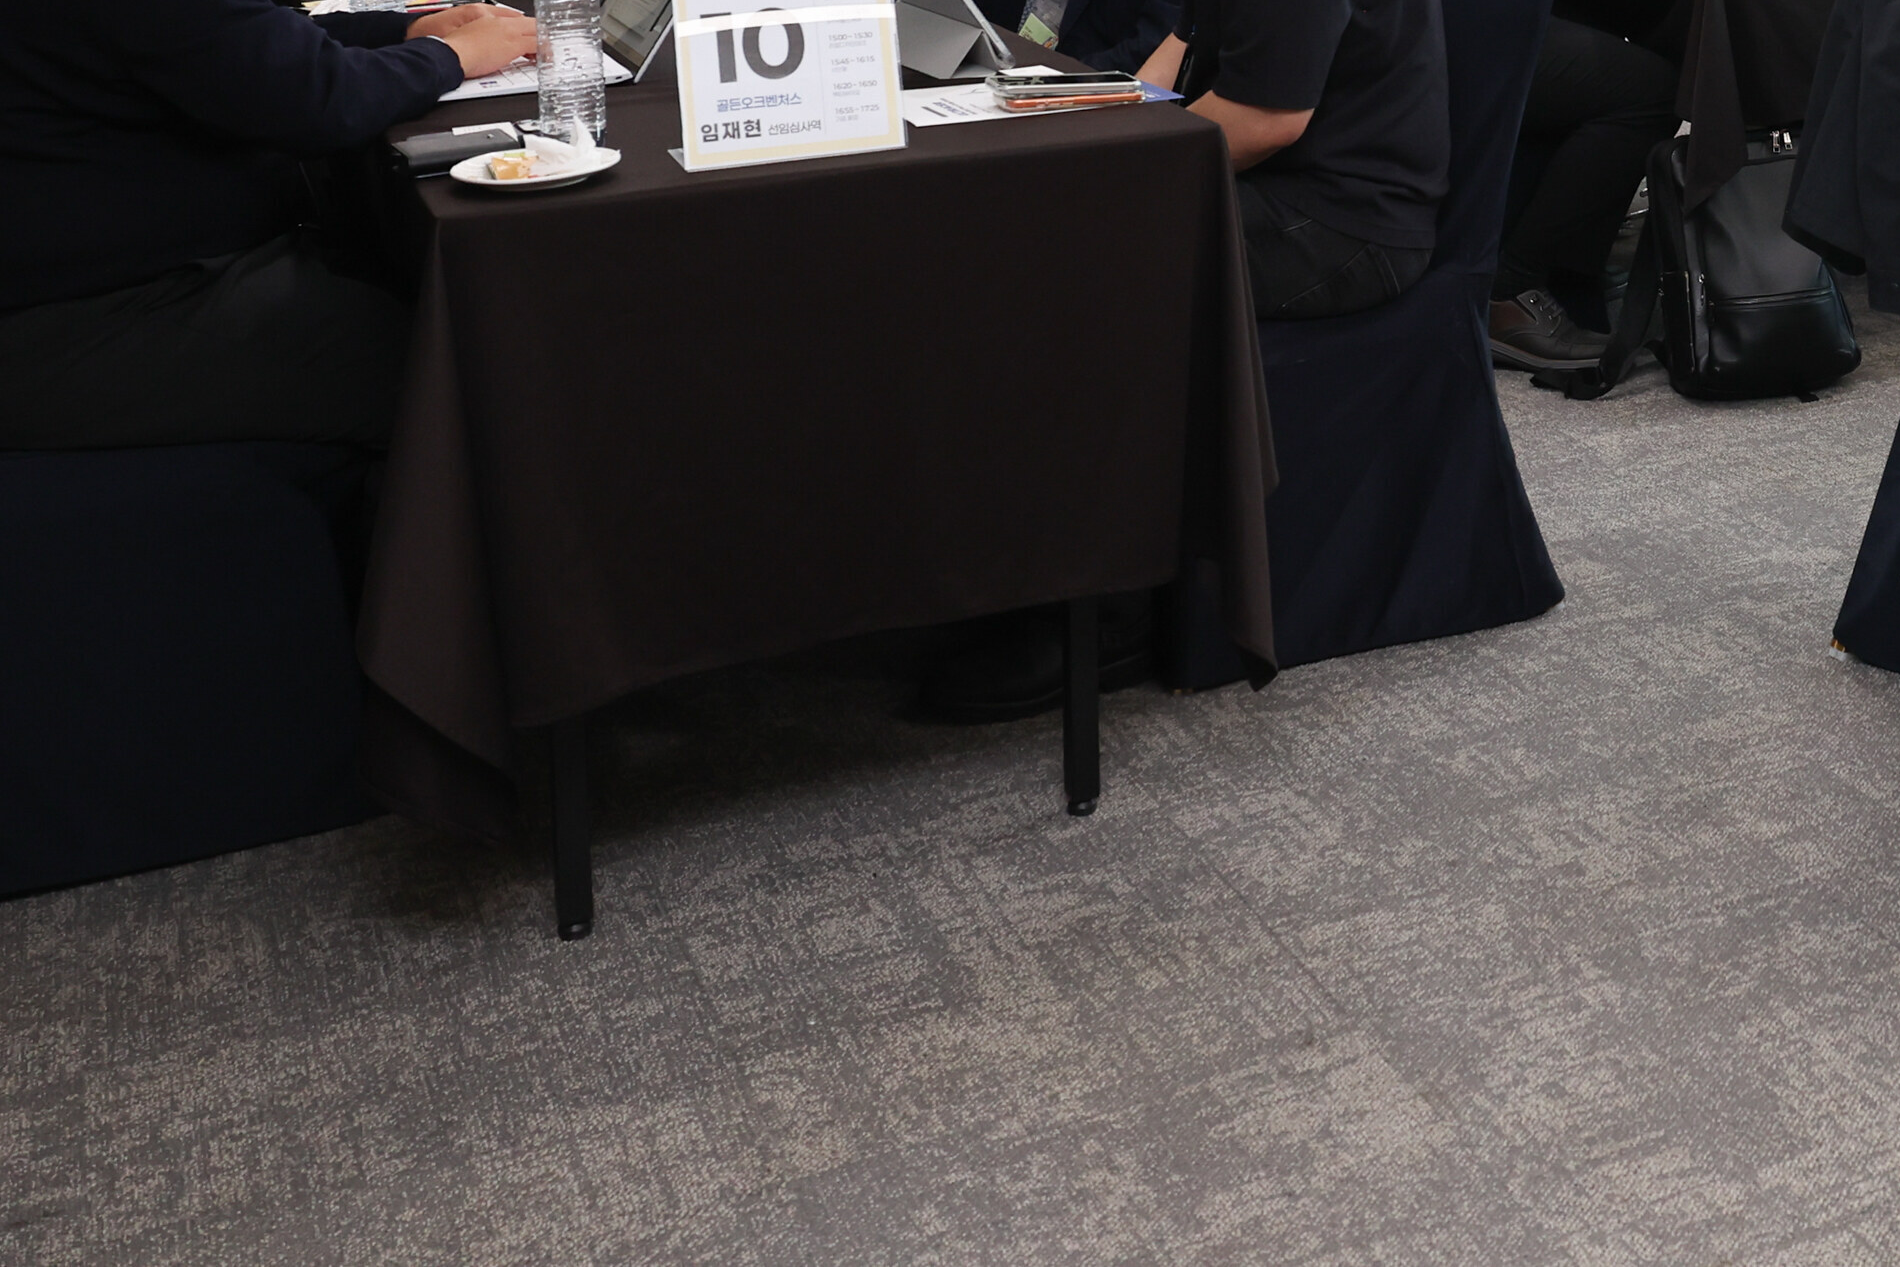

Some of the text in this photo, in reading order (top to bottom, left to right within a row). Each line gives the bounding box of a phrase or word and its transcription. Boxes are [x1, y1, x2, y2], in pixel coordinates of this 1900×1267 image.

[700, 7, 805, 84] 10
[716, 92, 802, 113] 골든오크벤처스
[700, 119, 822, 143] 임재현 선임심사역
